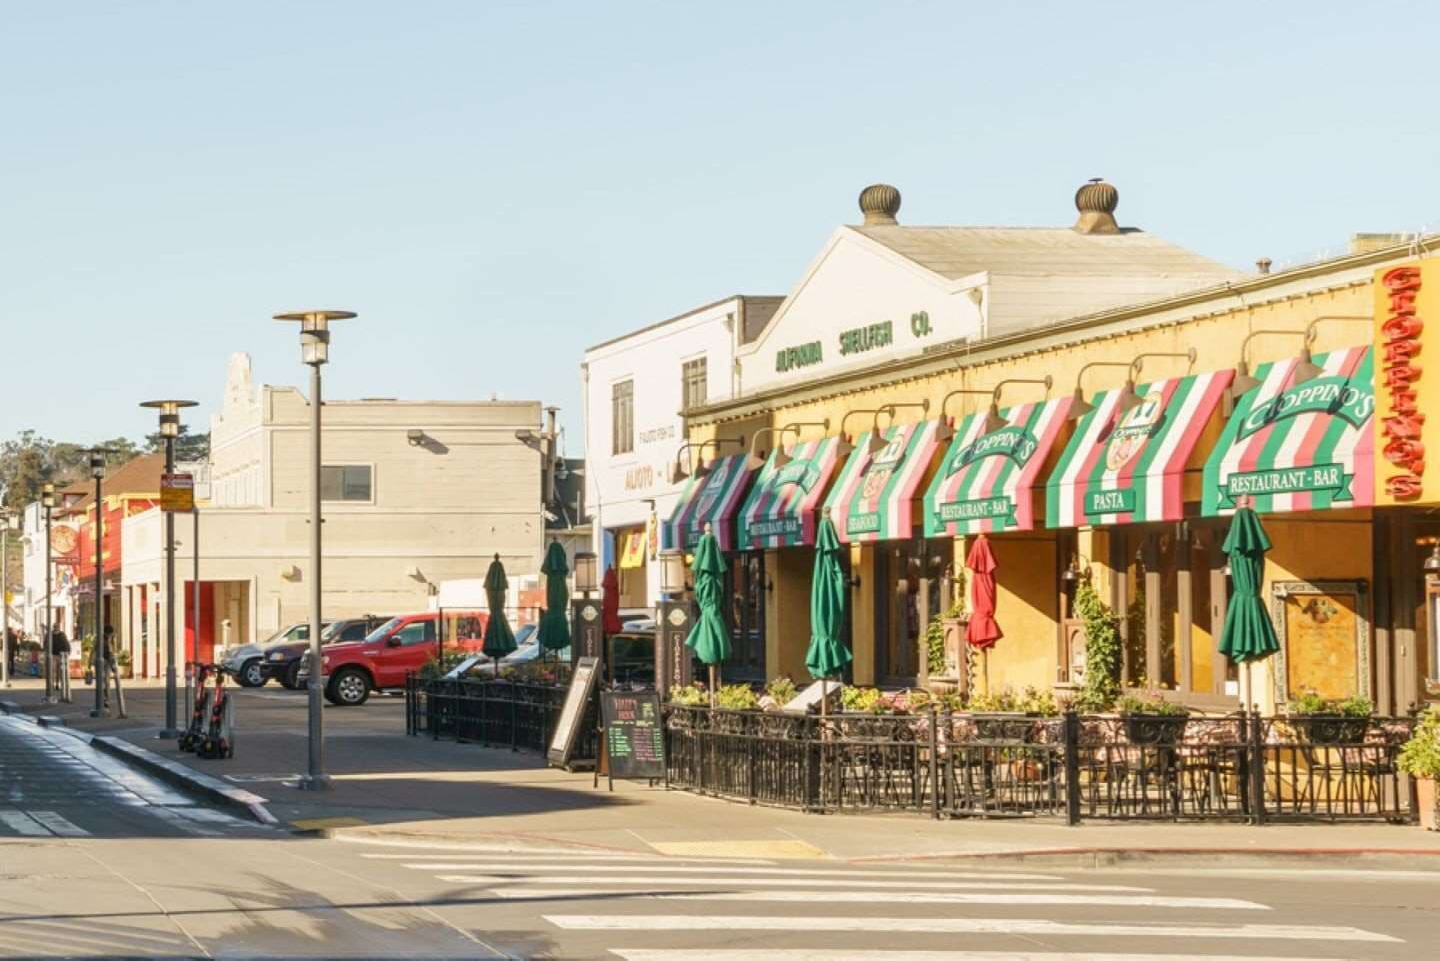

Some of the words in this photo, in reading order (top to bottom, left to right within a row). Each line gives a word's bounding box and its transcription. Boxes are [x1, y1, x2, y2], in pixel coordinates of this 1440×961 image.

[1245, 385, 1375, 430] CIOPPINO'S
[1231, 472, 1306, 493] RESTAURANT
[1314, 469, 1339, 486] BAR
[941, 503, 987, 518] RESTAURANT
[993, 501, 1009, 514] BAR
[1094, 492, 1124, 511] PASTA
